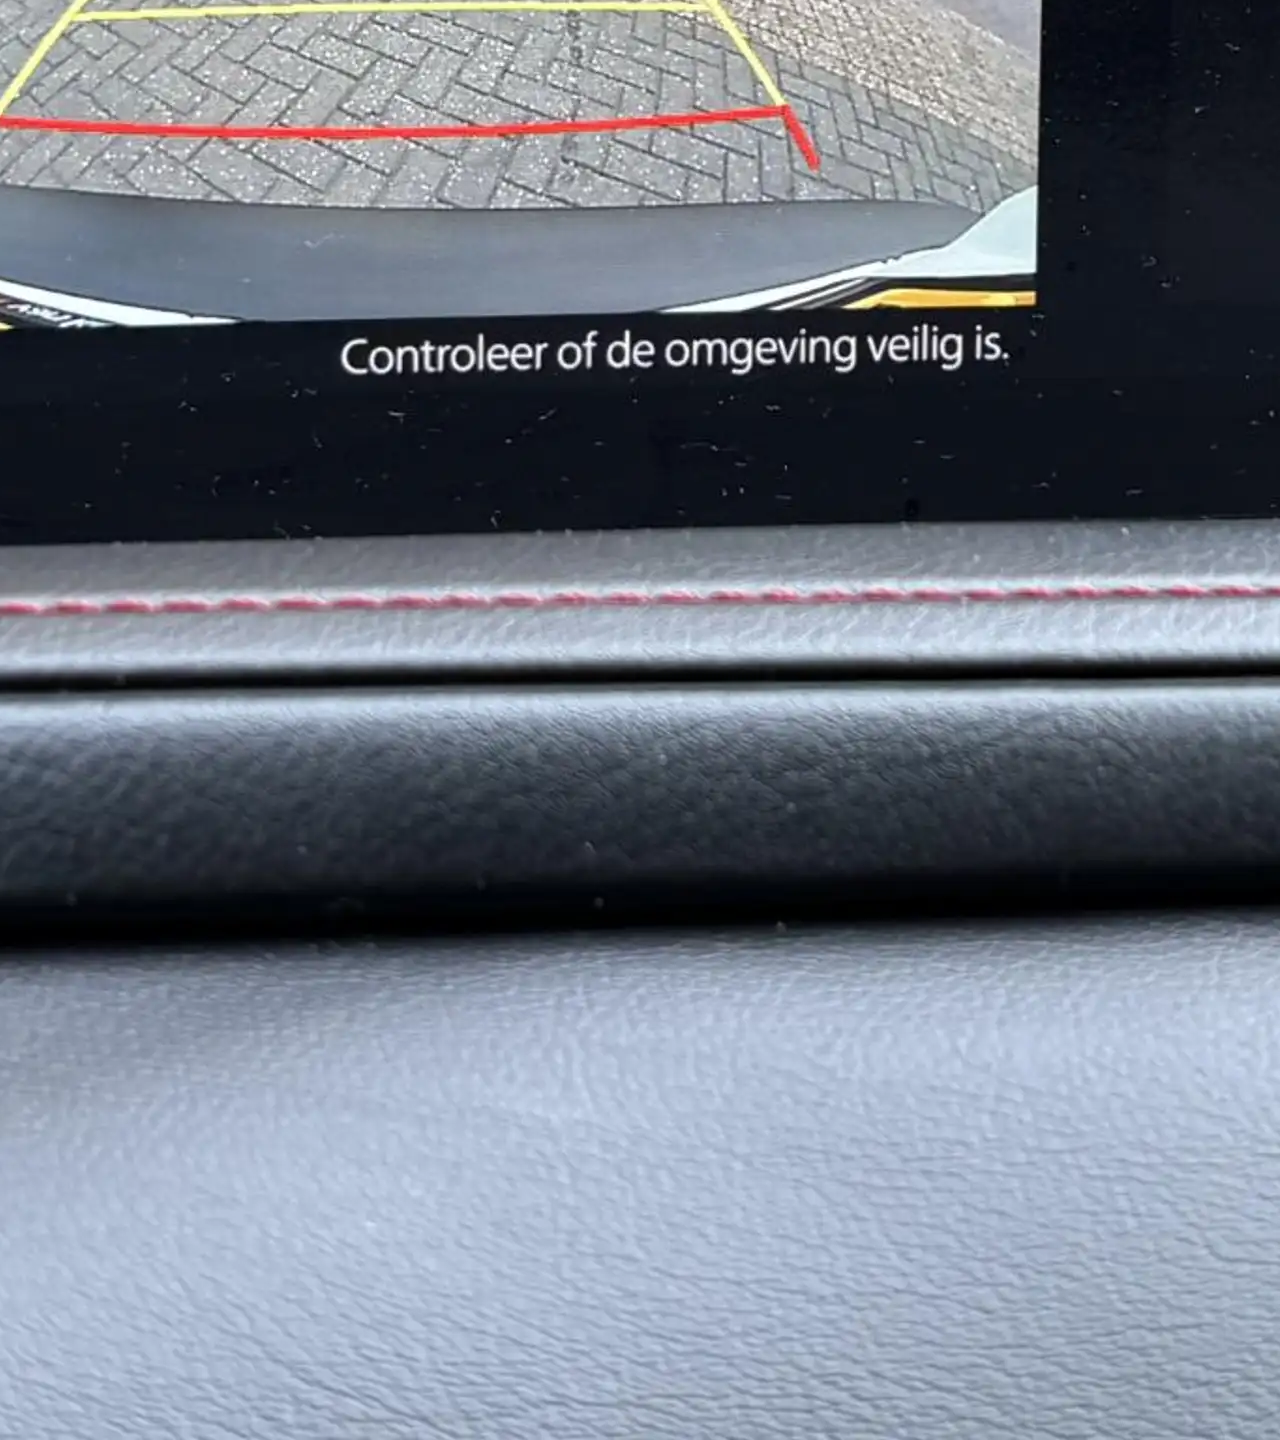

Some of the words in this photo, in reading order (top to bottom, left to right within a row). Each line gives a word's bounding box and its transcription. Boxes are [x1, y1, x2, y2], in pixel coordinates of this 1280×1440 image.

[340, 333, 549, 375] Controleer
[557, 330, 598, 370] of
[606, 329, 656, 369] de
[664, 328, 857, 375] omgeving
[866, 323, 964, 371] veilig
[975, 324, 1009, 362] is.
